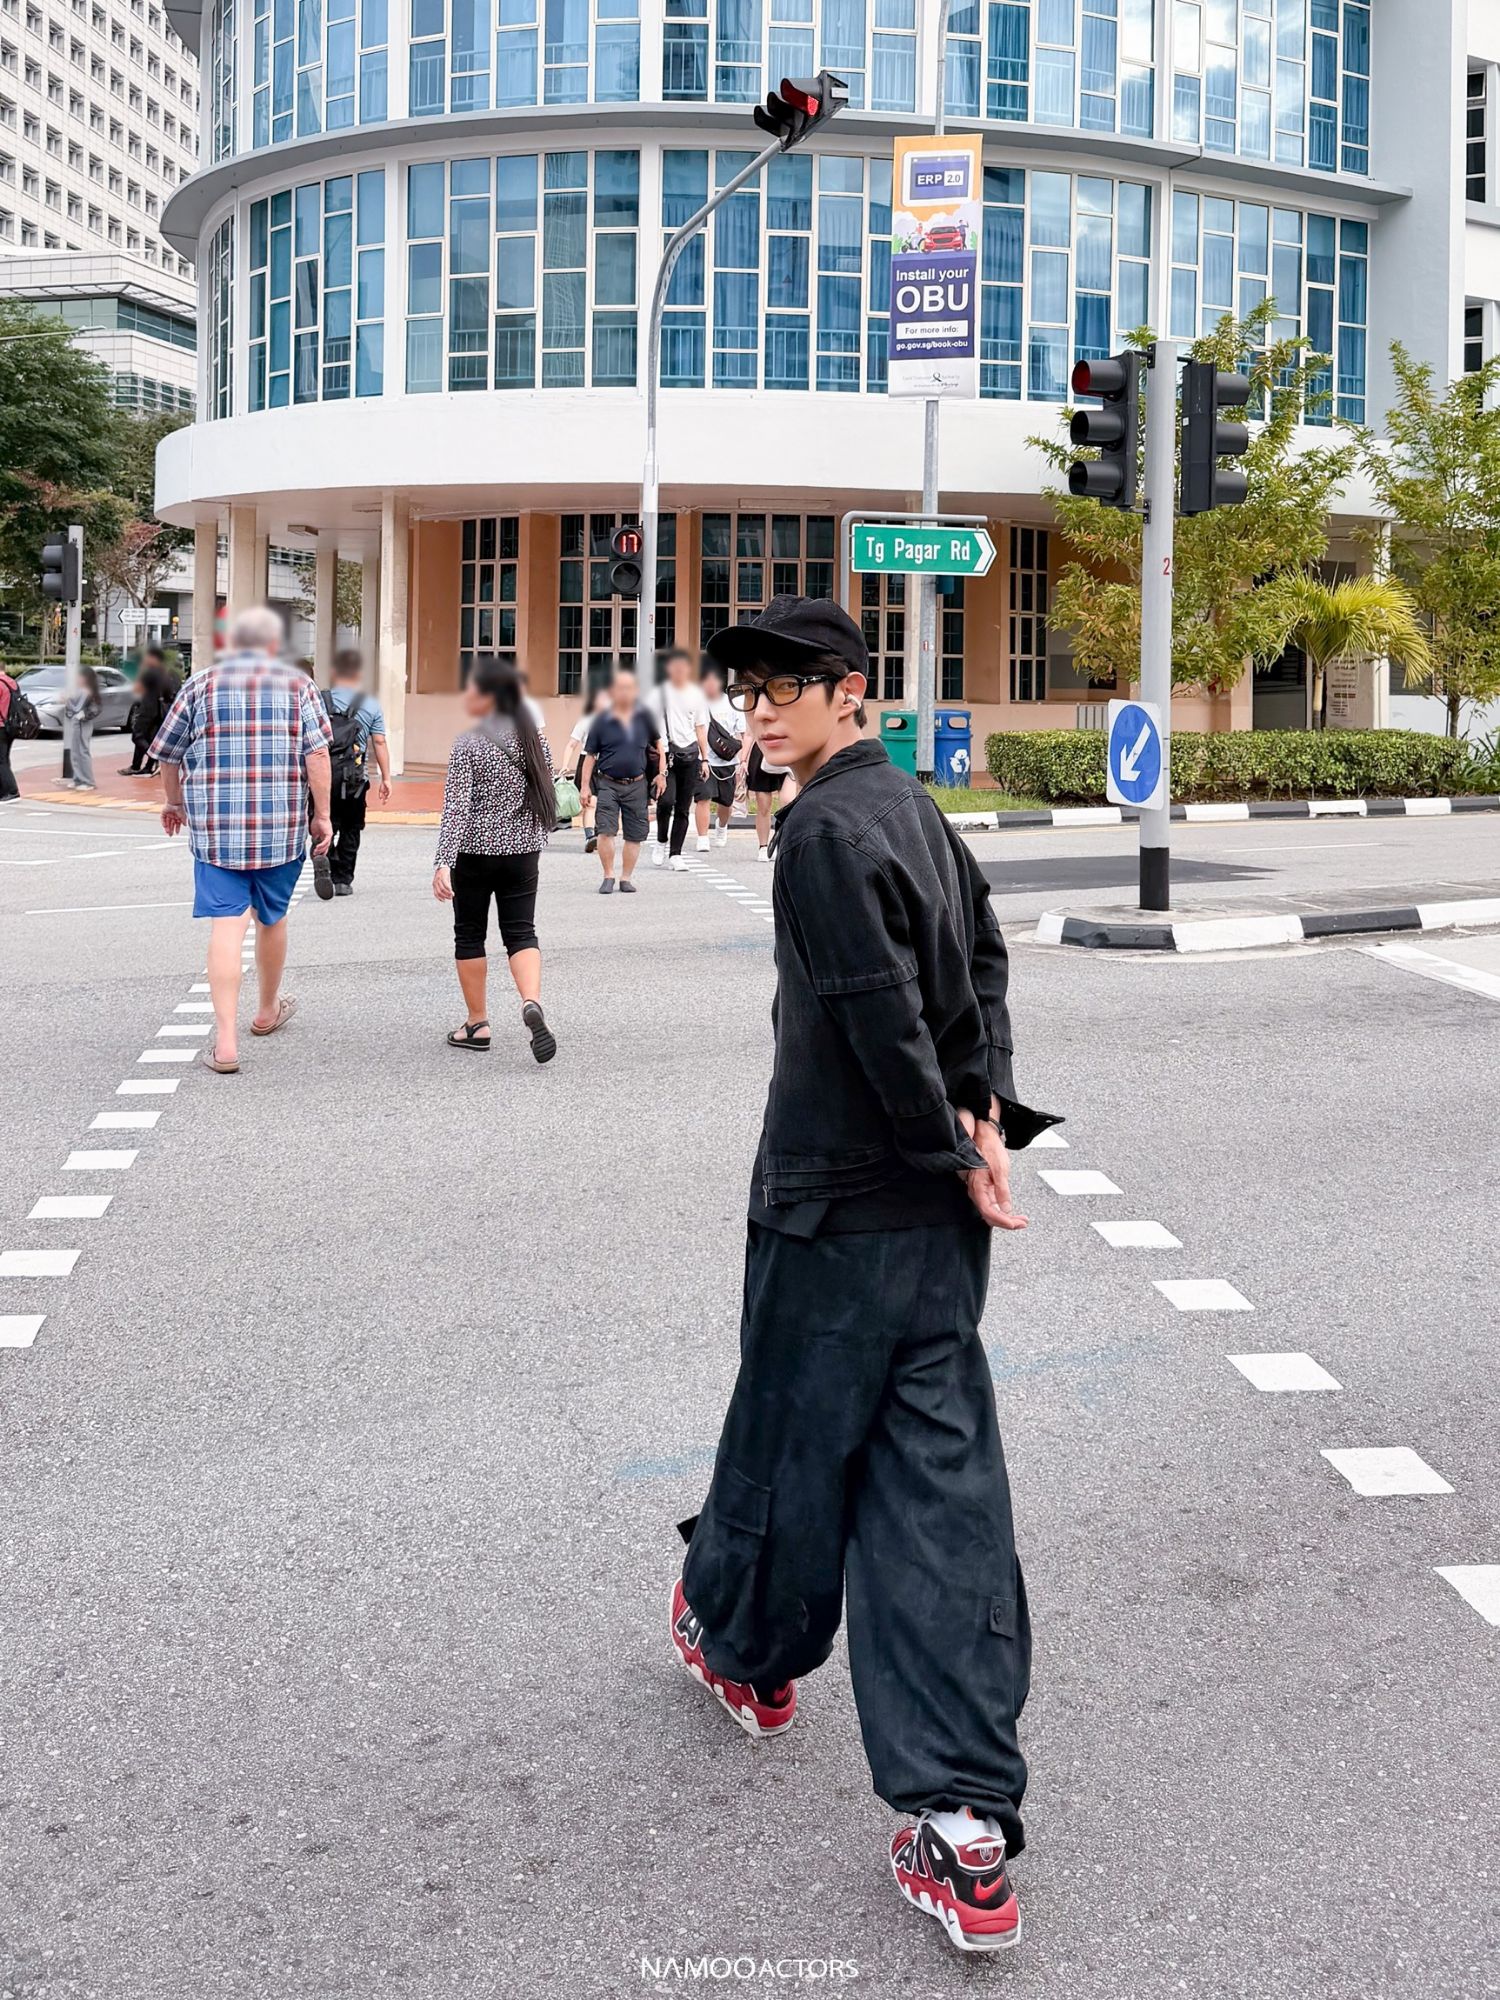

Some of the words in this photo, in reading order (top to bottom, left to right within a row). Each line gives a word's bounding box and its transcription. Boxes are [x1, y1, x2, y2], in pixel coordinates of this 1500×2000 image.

[917, 174, 943, 185] ERP
[947, 174, 961, 183] 2.0
[896, 268, 936, 282] Install
[939, 268, 969, 282] your
[896, 283, 969, 314] OBU
[905, 327, 918, 335] For
[942, 325, 960, 333] info:
[896, 340, 969, 351] go.gov.sg/book-obu
[623, 534, 638, 553] 17
[866, 536, 885, 563] Tg
[894, 537, 941, 564] Pagar
[950, 539, 971, 561] Rd
[1163, 557, 1171, 576] 2
